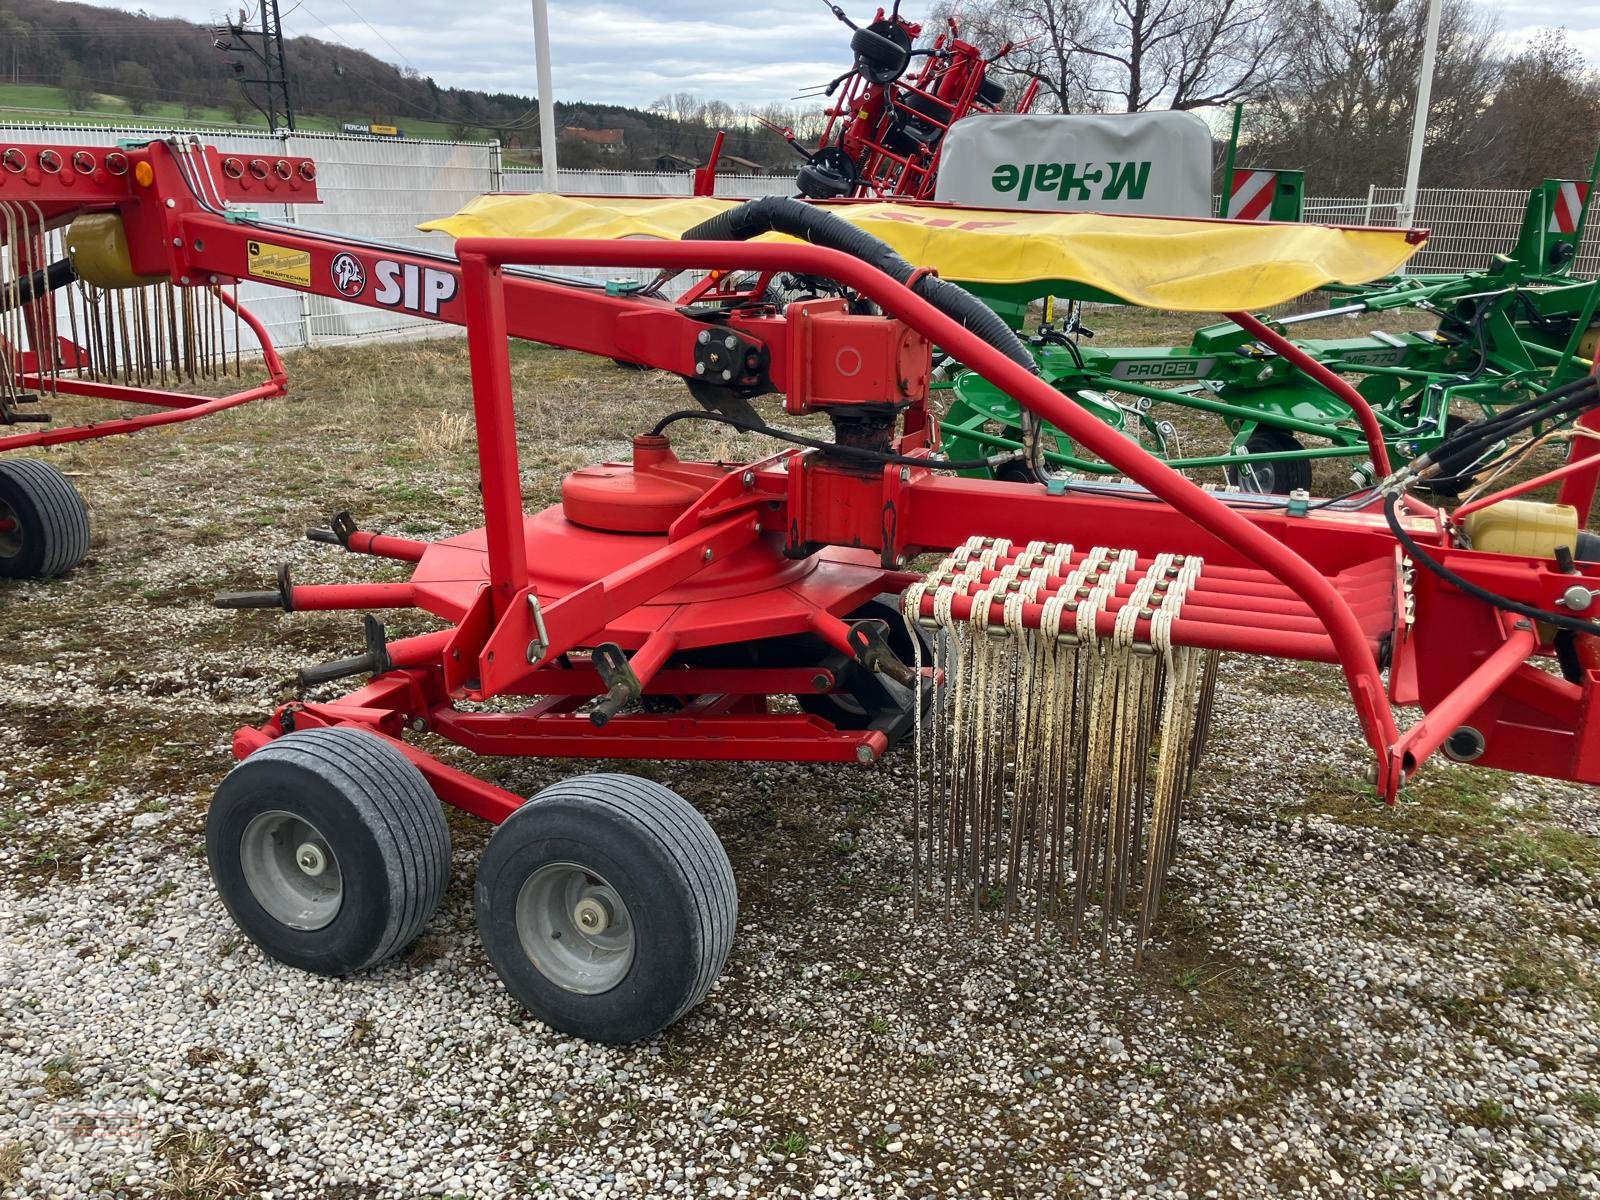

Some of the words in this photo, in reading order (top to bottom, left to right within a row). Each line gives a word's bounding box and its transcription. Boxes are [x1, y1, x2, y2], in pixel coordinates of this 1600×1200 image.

[991, 161, 1153, 202] McHale
[374, 259, 458, 315] SIP
[1126, 361, 1199, 376] PROPEL
